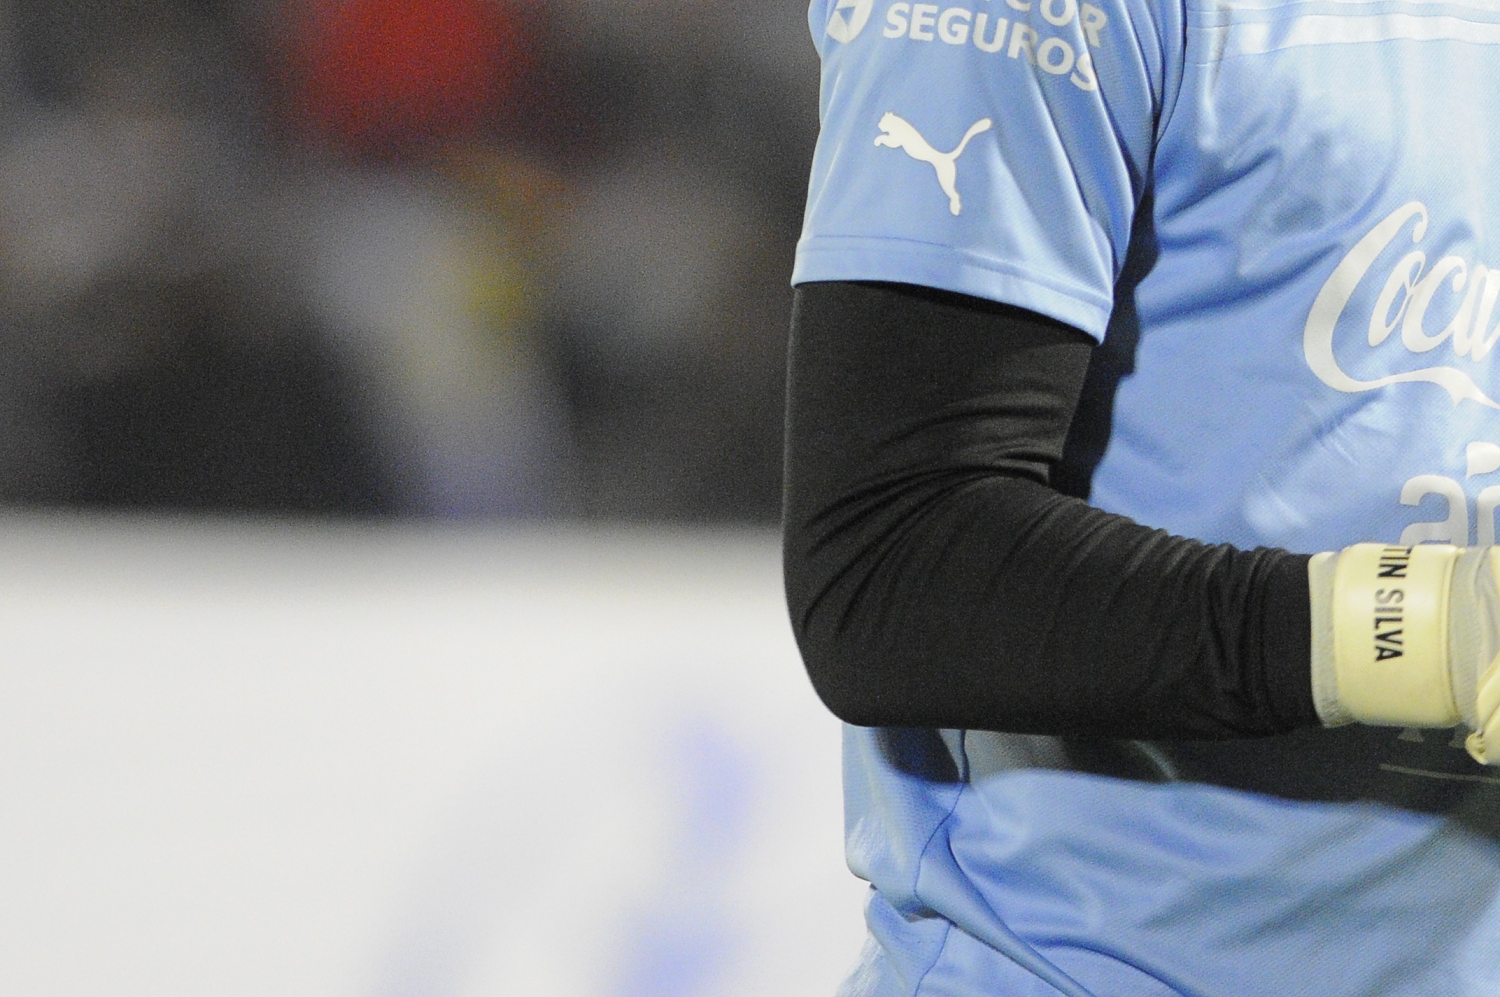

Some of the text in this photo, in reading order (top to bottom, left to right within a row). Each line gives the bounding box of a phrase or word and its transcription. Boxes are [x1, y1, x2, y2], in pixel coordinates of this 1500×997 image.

[882, 2, 1099, 92] SEGUROS
[1373, 545, 1413, 663] TIN SILVA
